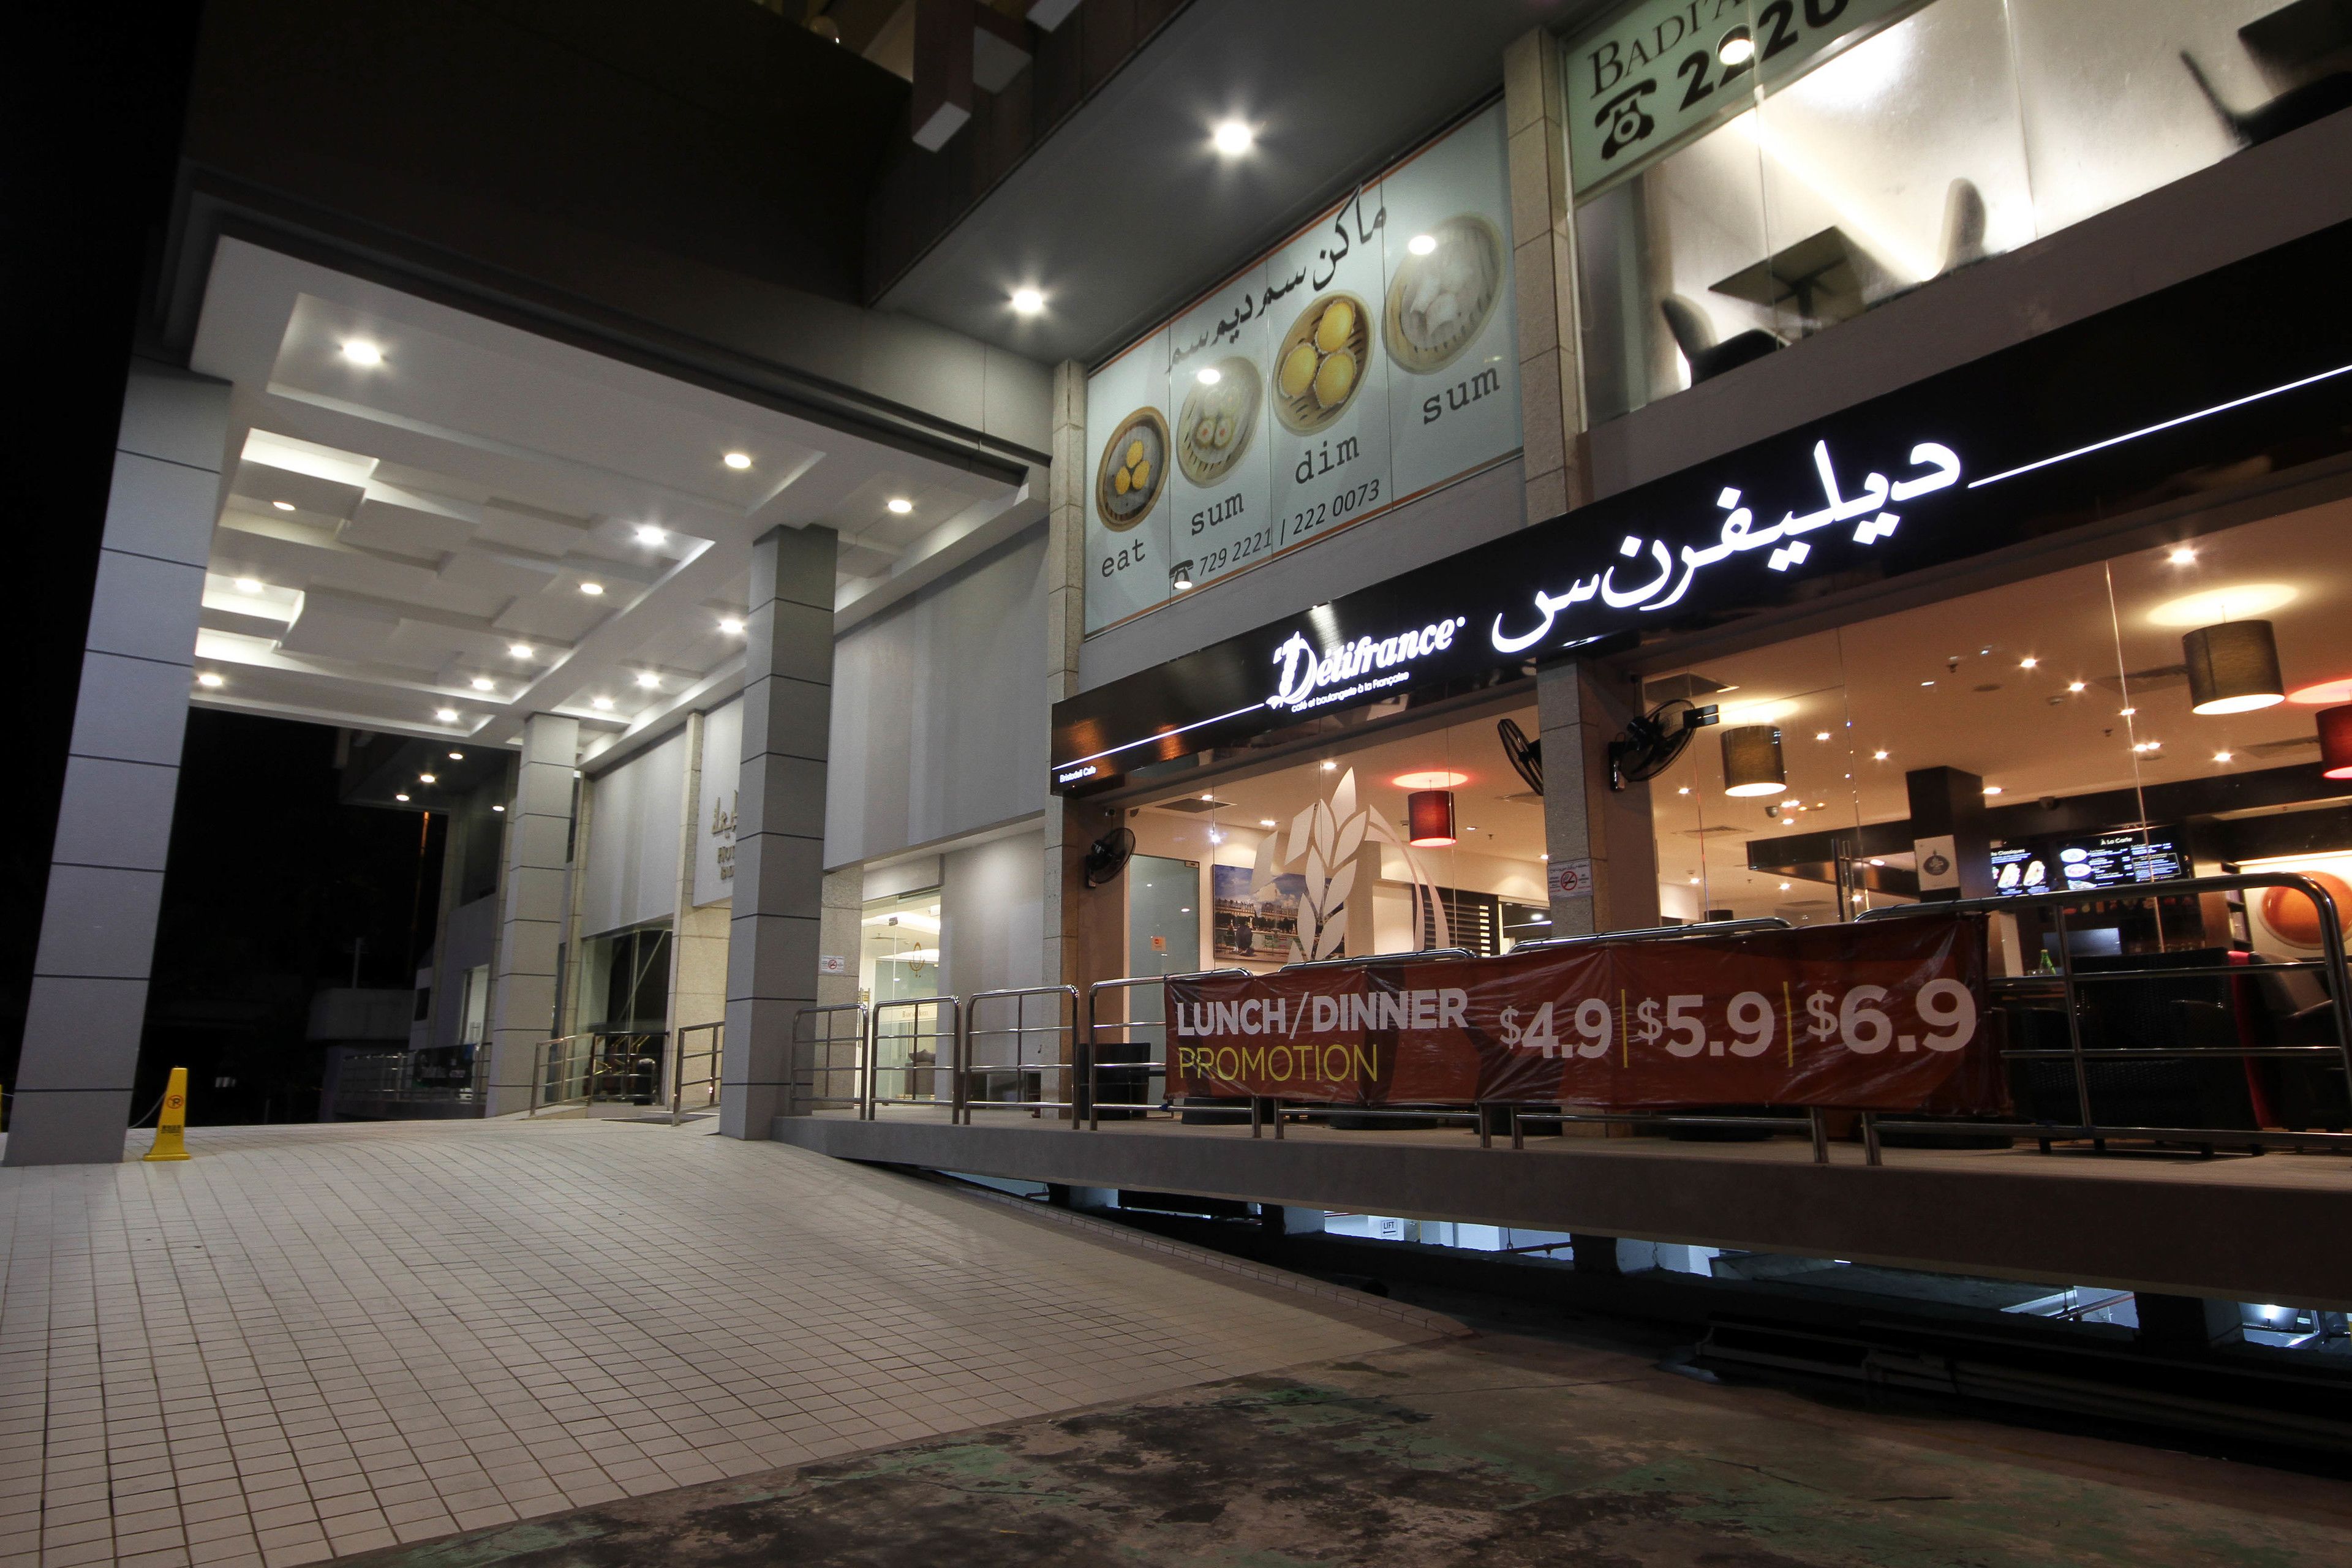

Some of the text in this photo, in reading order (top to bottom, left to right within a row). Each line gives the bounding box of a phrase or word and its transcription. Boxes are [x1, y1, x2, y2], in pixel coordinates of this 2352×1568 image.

[1102, 368, 1500, 578] eat sum dim sum
[1199, 549, 1226, 576] 729
[1232, 528, 1272, 562] 2221
[1292, 503, 1326, 535] 222
[1333, 478, 1380, 516] 0073
[1499, 978, 1977, 1059] $4.9 $5.9 $6.9
[1178, 1044, 1378, 1082] PROMOTION
[1383, 1221, 1395, 1229] LIFT
